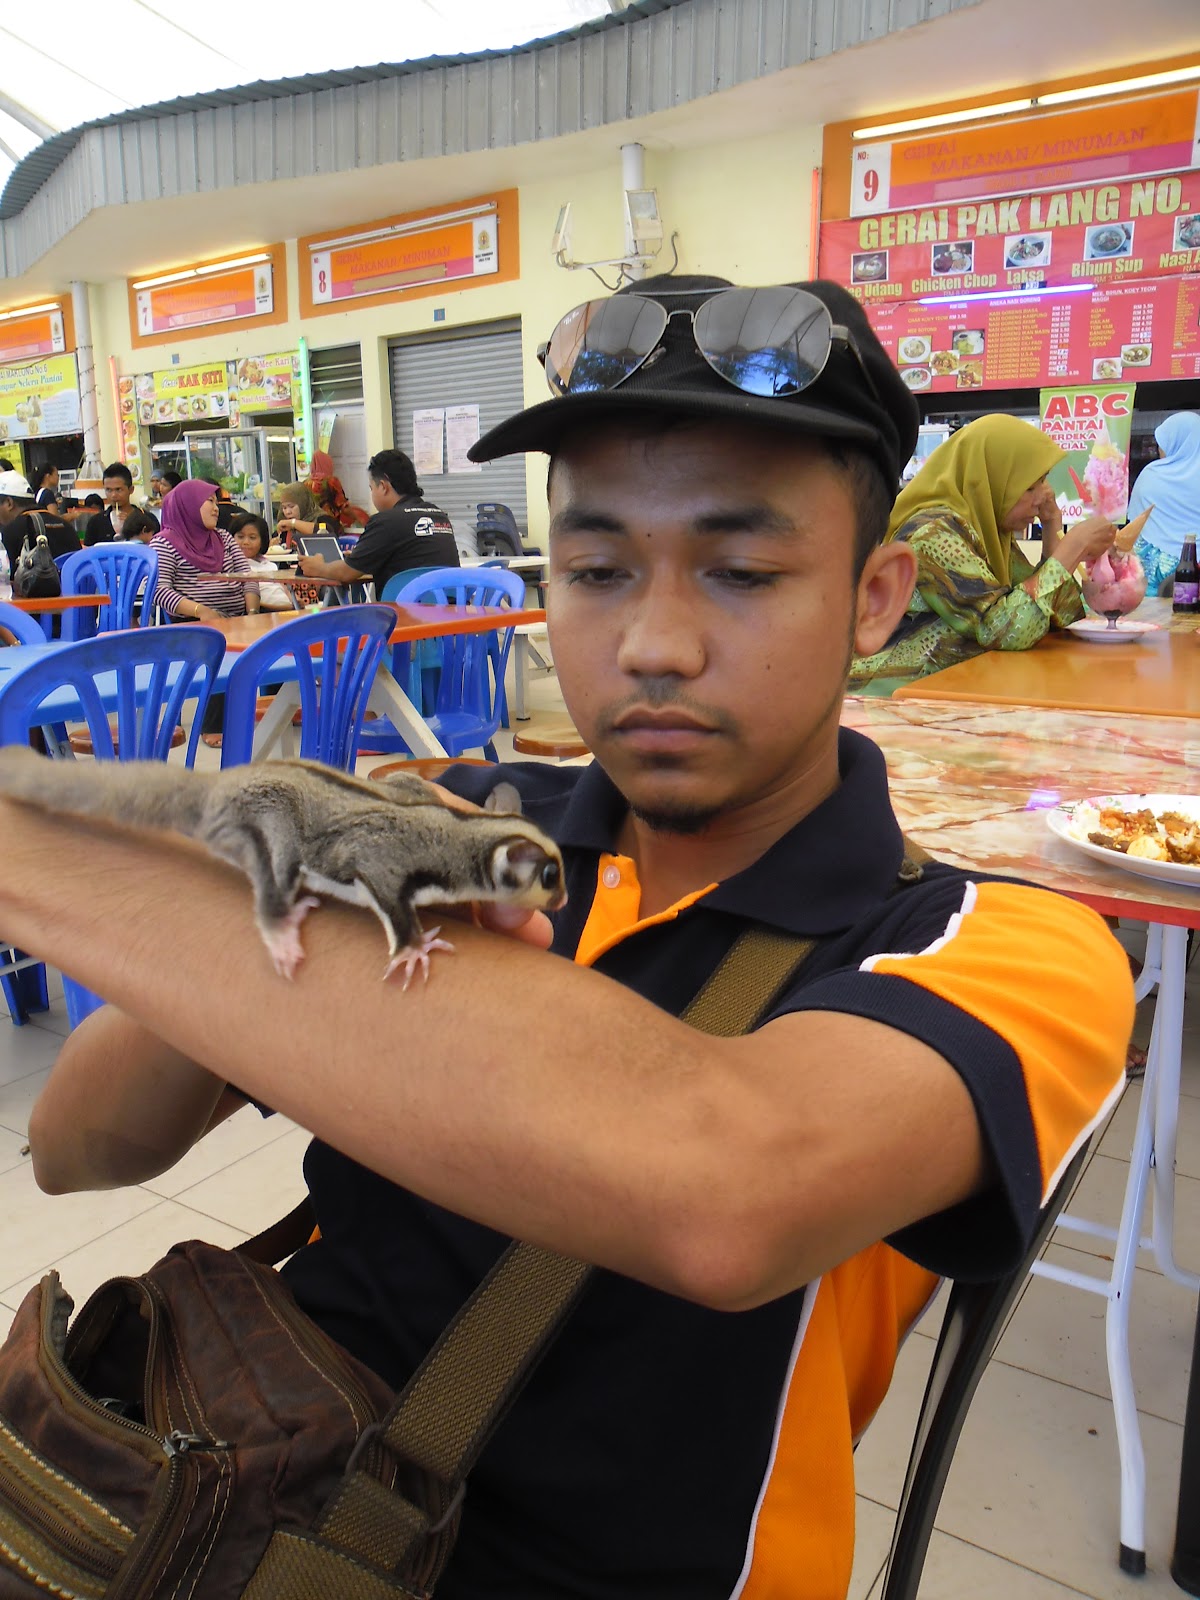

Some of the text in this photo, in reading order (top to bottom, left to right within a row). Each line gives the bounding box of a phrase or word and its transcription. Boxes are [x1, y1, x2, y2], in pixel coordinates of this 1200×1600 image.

[903, 139, 957, 161] GERAI
[863, 169, 879, 202] 9
[858, 178, 1191, 250] GERAI PAK LANG NO.
[1071, 258, 1144, 278] Bihun Sup
[1159, 250, 1192, 268] Nasi
[318, 270, 326, 294] 8
[911, 273, 997, 294] Chicken Chop
[1006, 269, 1045, 285] Laksa
[844, 283, 903, 299] ee Udang
[142, 307, 148, 327] 7
[258, 356, 290, 369] Mee Kari
[40, 371, 63, 385] Pantai
[178, 373, 200, 389] KAK
[202, 370, 223, 385] SITI
[1043, 392, 1130, 420] ABC
[1041, 419, 1104, 433] PANTAI
[1048, 432, 1097, 441] ERDEKA
[1057, 442, 1087, 450] CIAL
